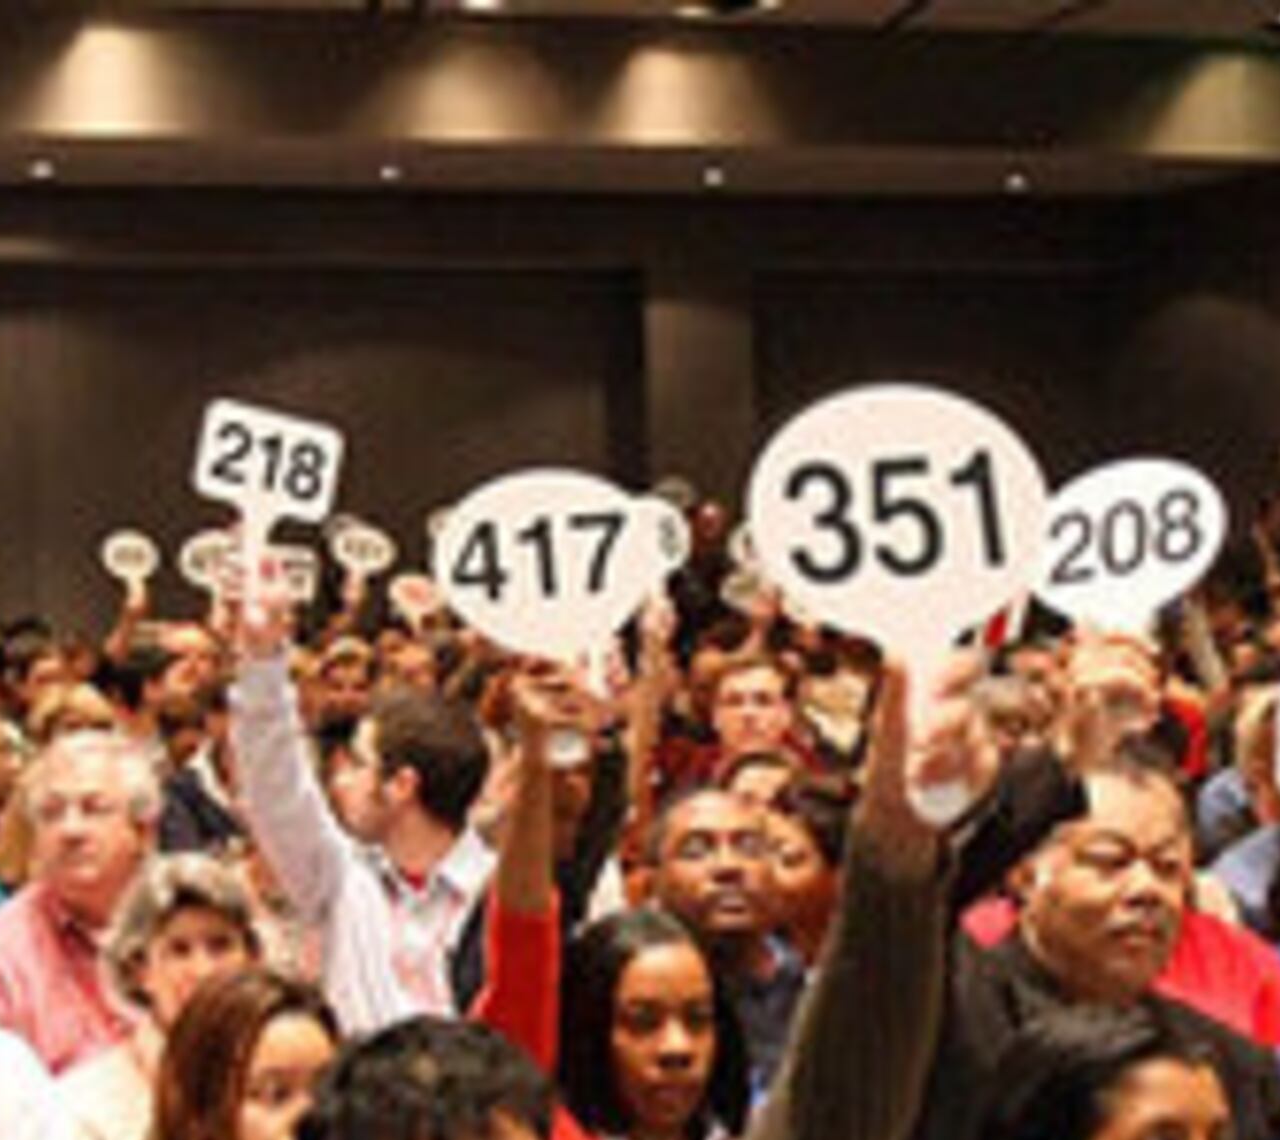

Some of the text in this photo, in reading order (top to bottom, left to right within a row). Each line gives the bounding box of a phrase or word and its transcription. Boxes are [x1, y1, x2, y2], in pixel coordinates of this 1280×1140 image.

[209, 420, 327, 503] 218
[450, 510, 627, 603] 417
[783, 449, 1006, 586] 351
[1048, 488, 1204, 587] 208
